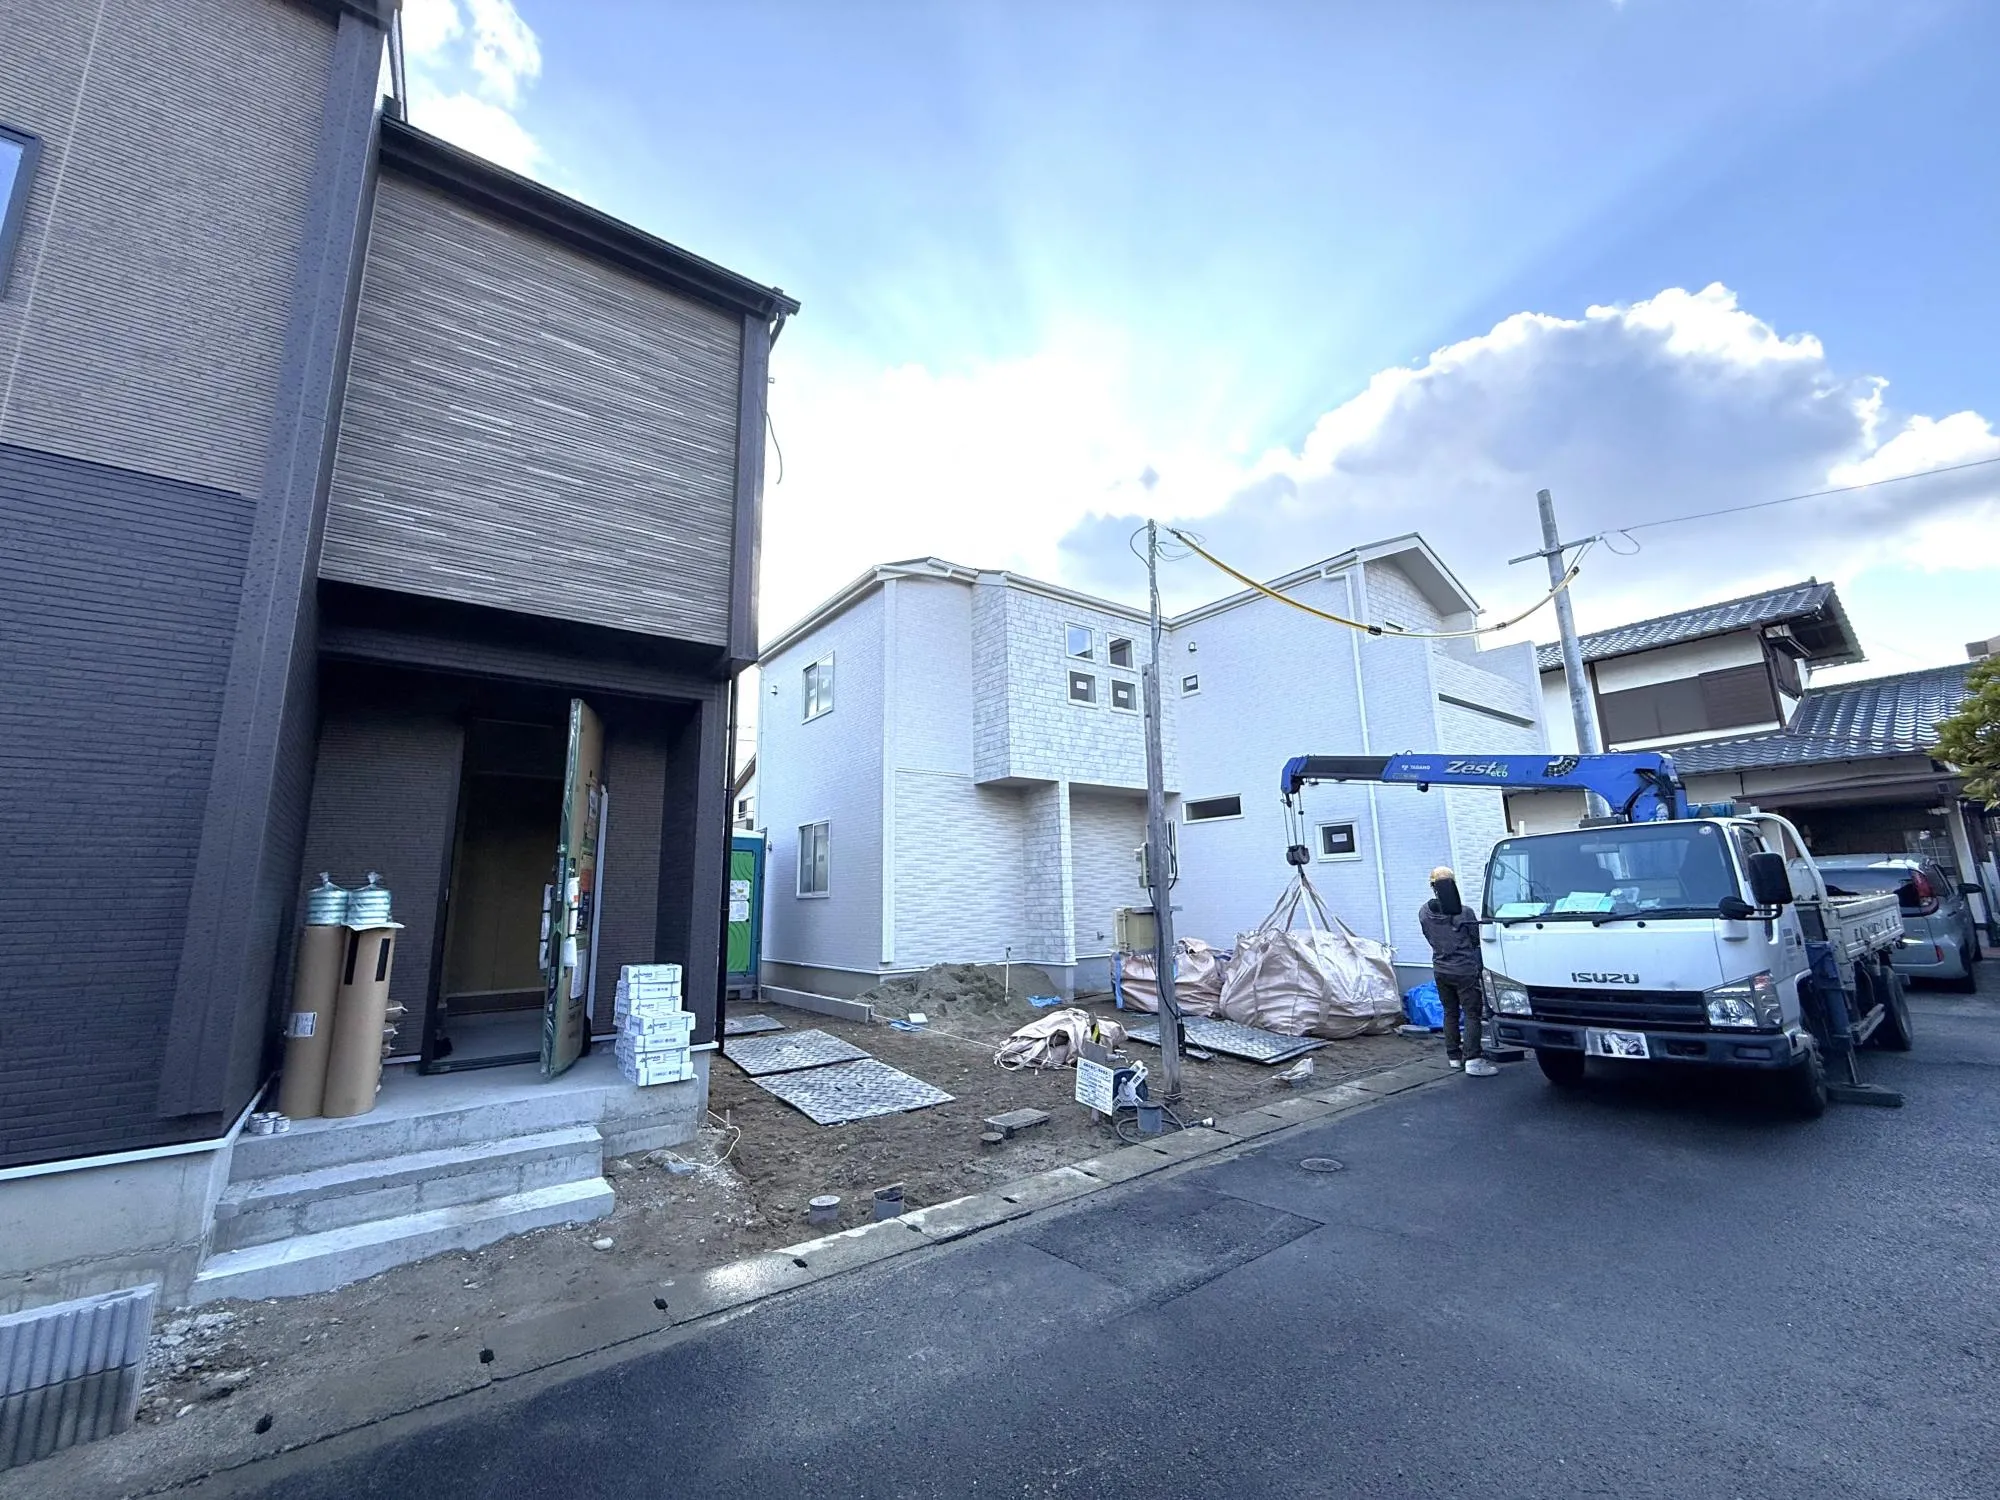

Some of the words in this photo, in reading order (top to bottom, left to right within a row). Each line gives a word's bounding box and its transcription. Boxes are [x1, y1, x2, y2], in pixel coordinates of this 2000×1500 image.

[1444, 760, 1498, 776] Zest
[1490, 769, 1508, 778] eco
[1571, 971, 1640, 984] ISUZU
